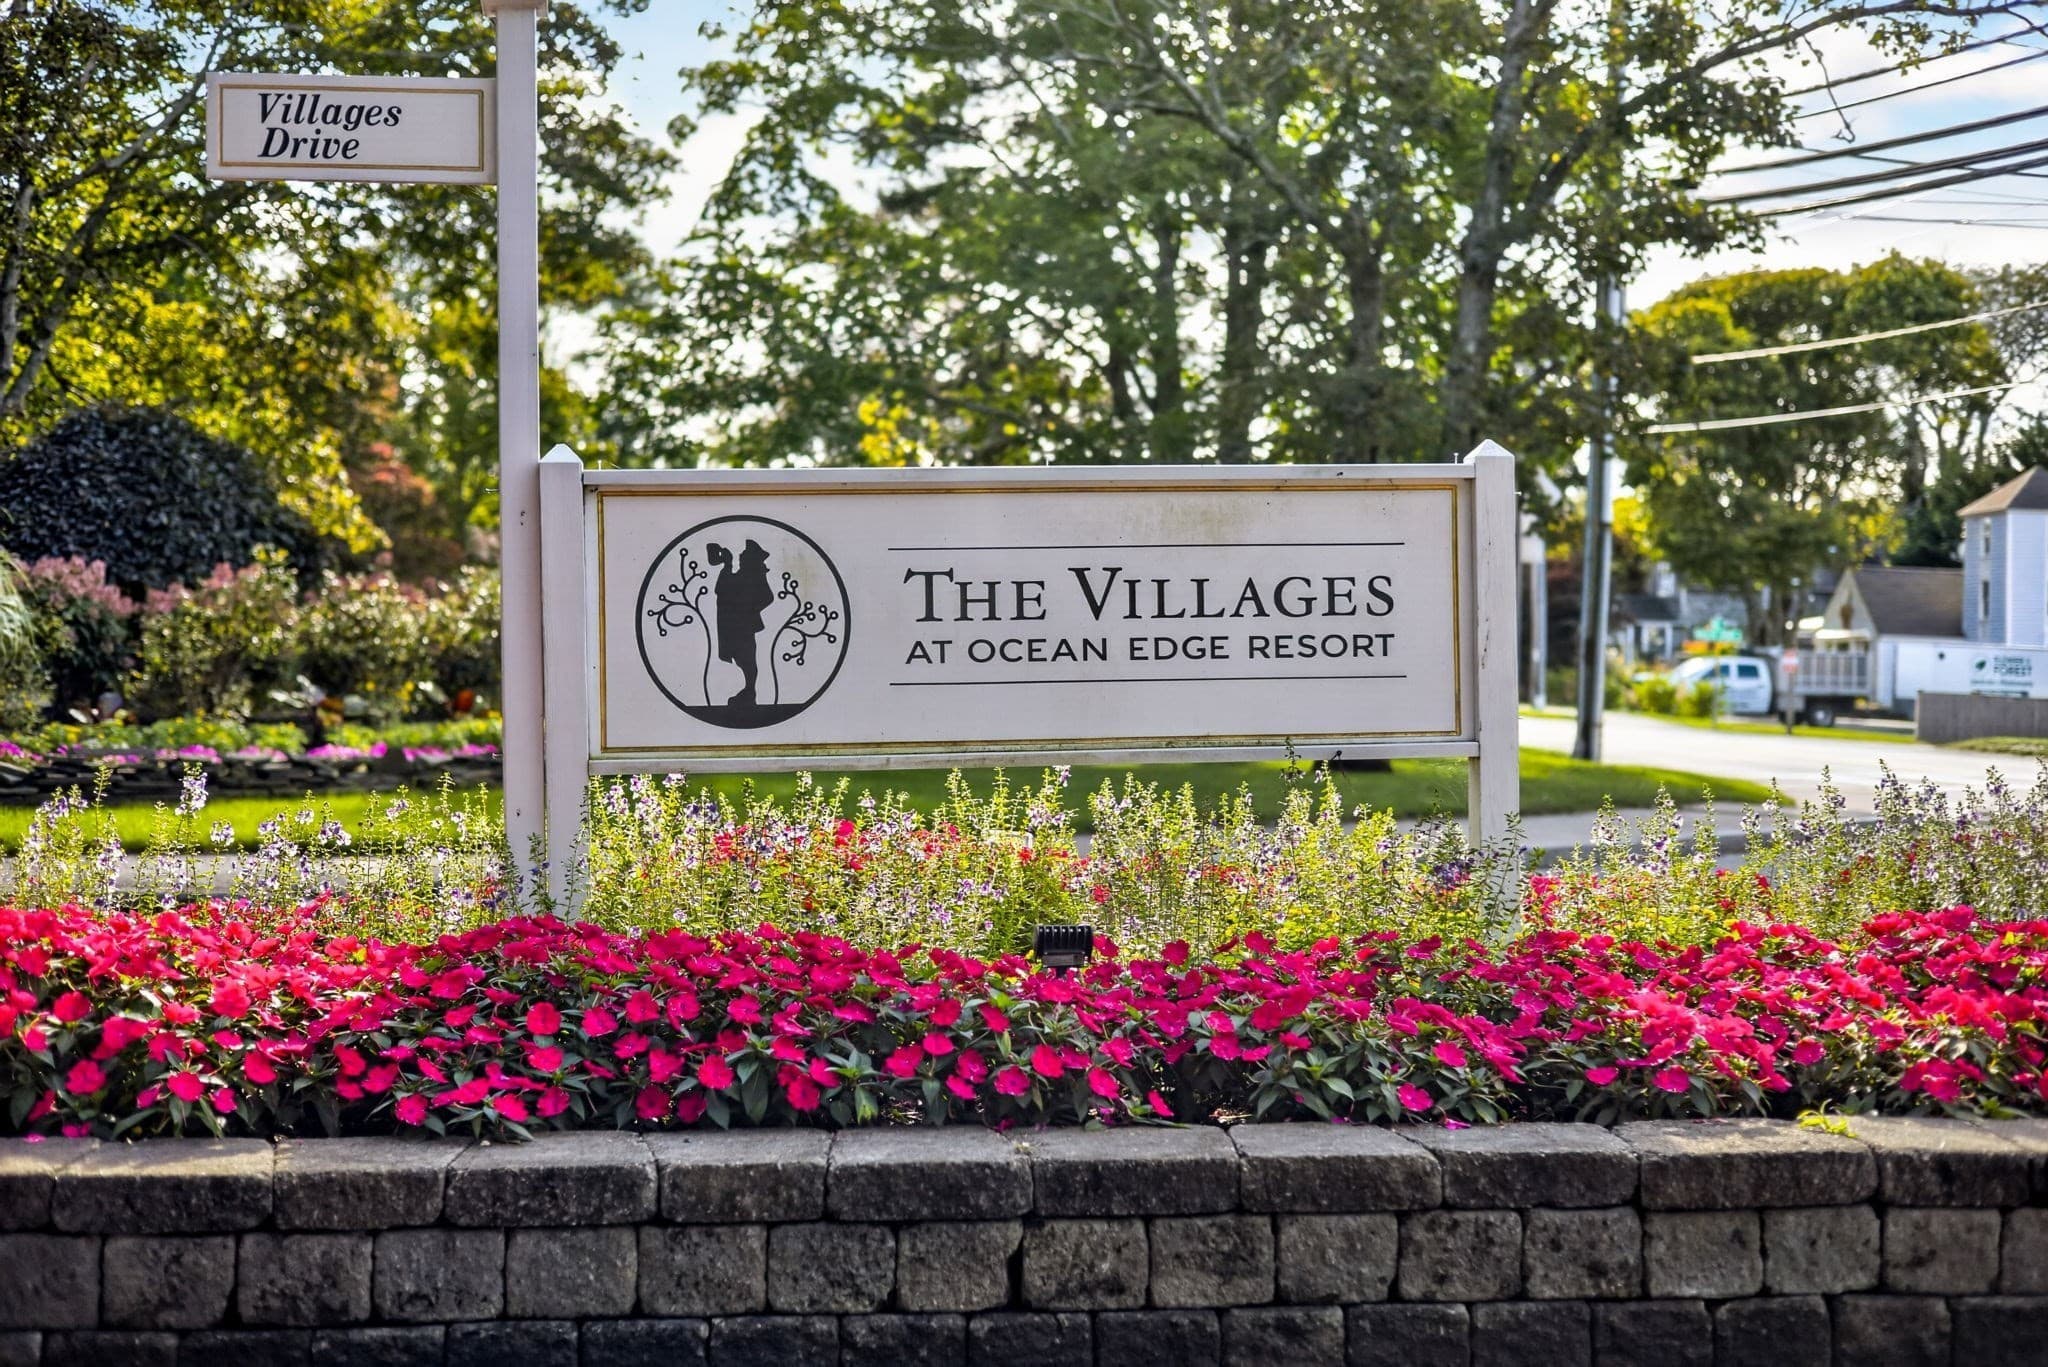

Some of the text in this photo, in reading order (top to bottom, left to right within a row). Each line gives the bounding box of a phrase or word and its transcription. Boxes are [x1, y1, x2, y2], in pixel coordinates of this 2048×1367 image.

[258, 92, 402, 131] Villages
[257, 127, 360, 159] Drive
[903, 566, 1395, 622] THE VILLAGES
[904, 633, 1396, 665] AT OCEAN EDGE RESORT
